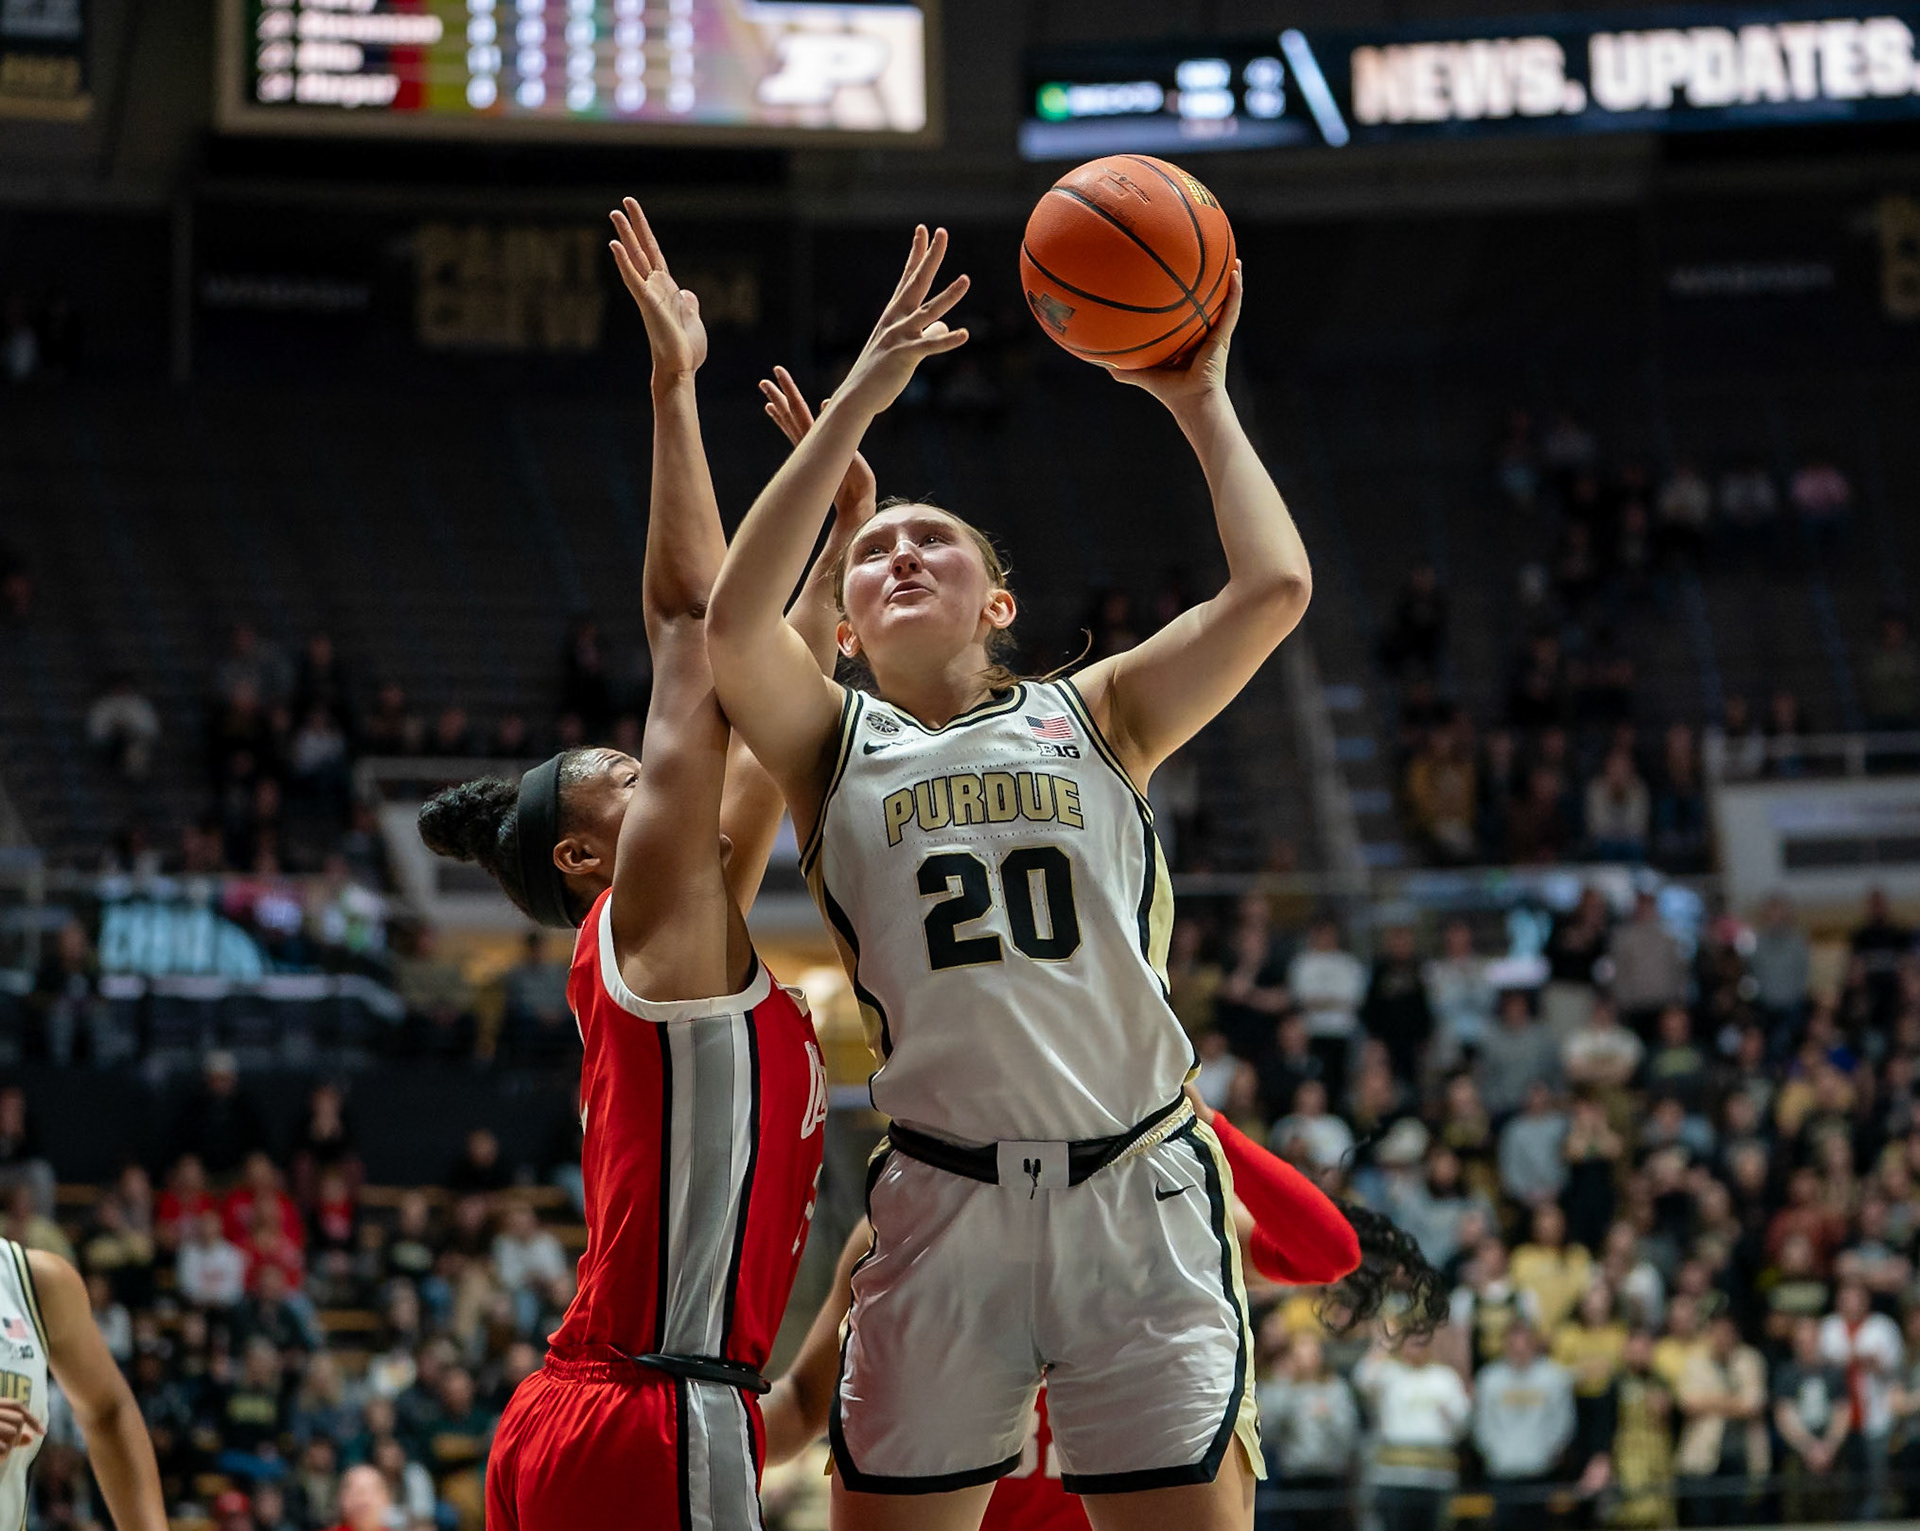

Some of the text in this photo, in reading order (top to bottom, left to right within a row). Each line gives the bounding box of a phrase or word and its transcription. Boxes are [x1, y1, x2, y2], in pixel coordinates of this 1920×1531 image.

[1352, 35, 1588, 125] NEWS.
[882, 771, 1084, 848] PURDUE
[915, 845, 1083, 972] 20
